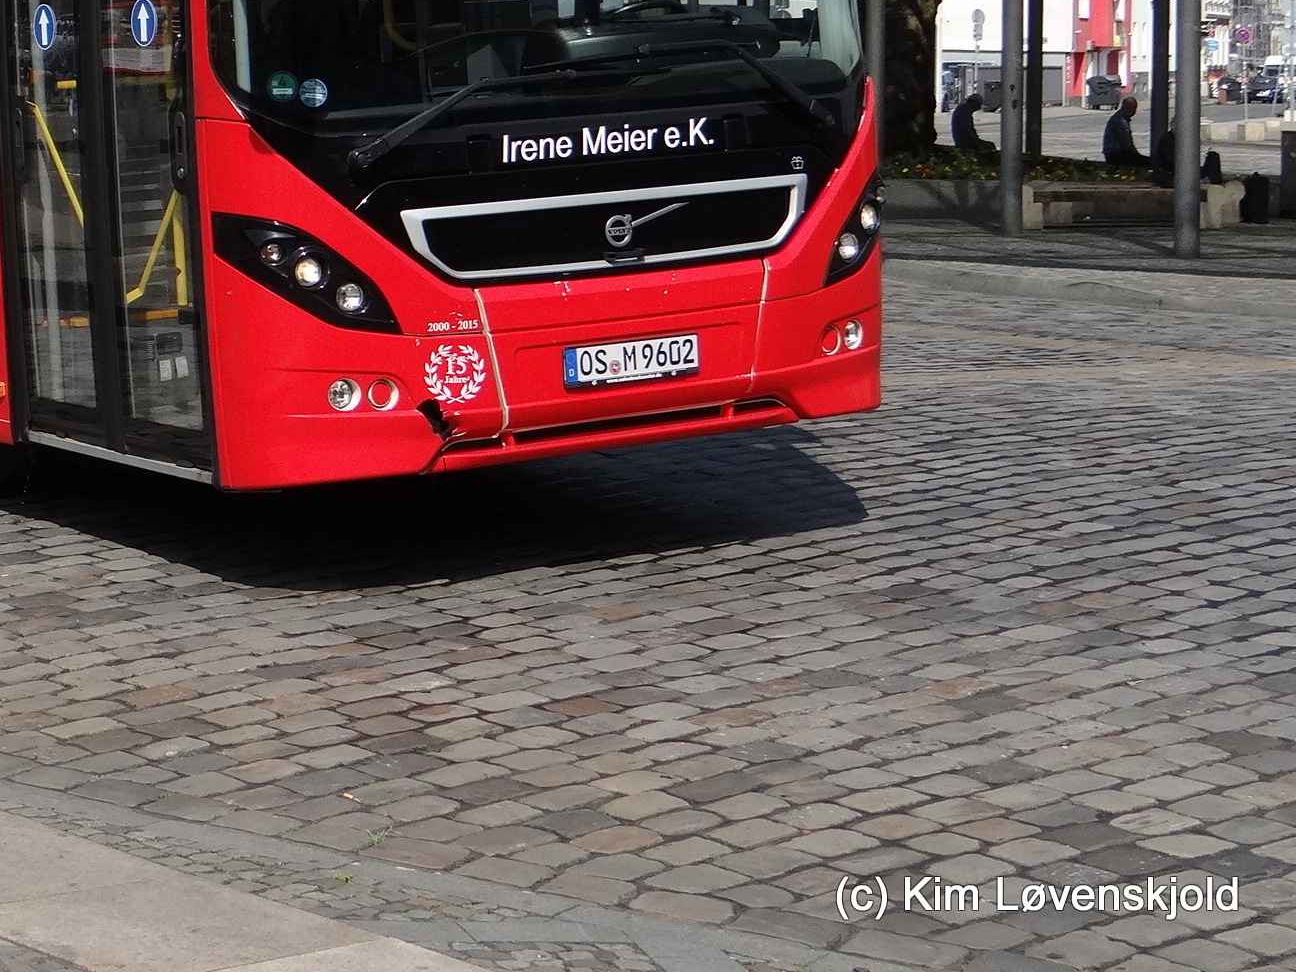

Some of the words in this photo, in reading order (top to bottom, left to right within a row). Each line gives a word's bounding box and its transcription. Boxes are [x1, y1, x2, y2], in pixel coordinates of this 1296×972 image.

[502, 134, 573, 163] Irene
[582, 124, 657, 156] Meier
[664, 117, 714, 148] e.K.
[427, 322, 450, 332] 2000
[457, 319, 479, 330] 2015
[446, 357, 467, 375] 15
[580, 349, 608, 376] OS
[622, 345, 637, 371] M
[642, 338, 695, 369] 9602
[569, 369, 575, 377] D
